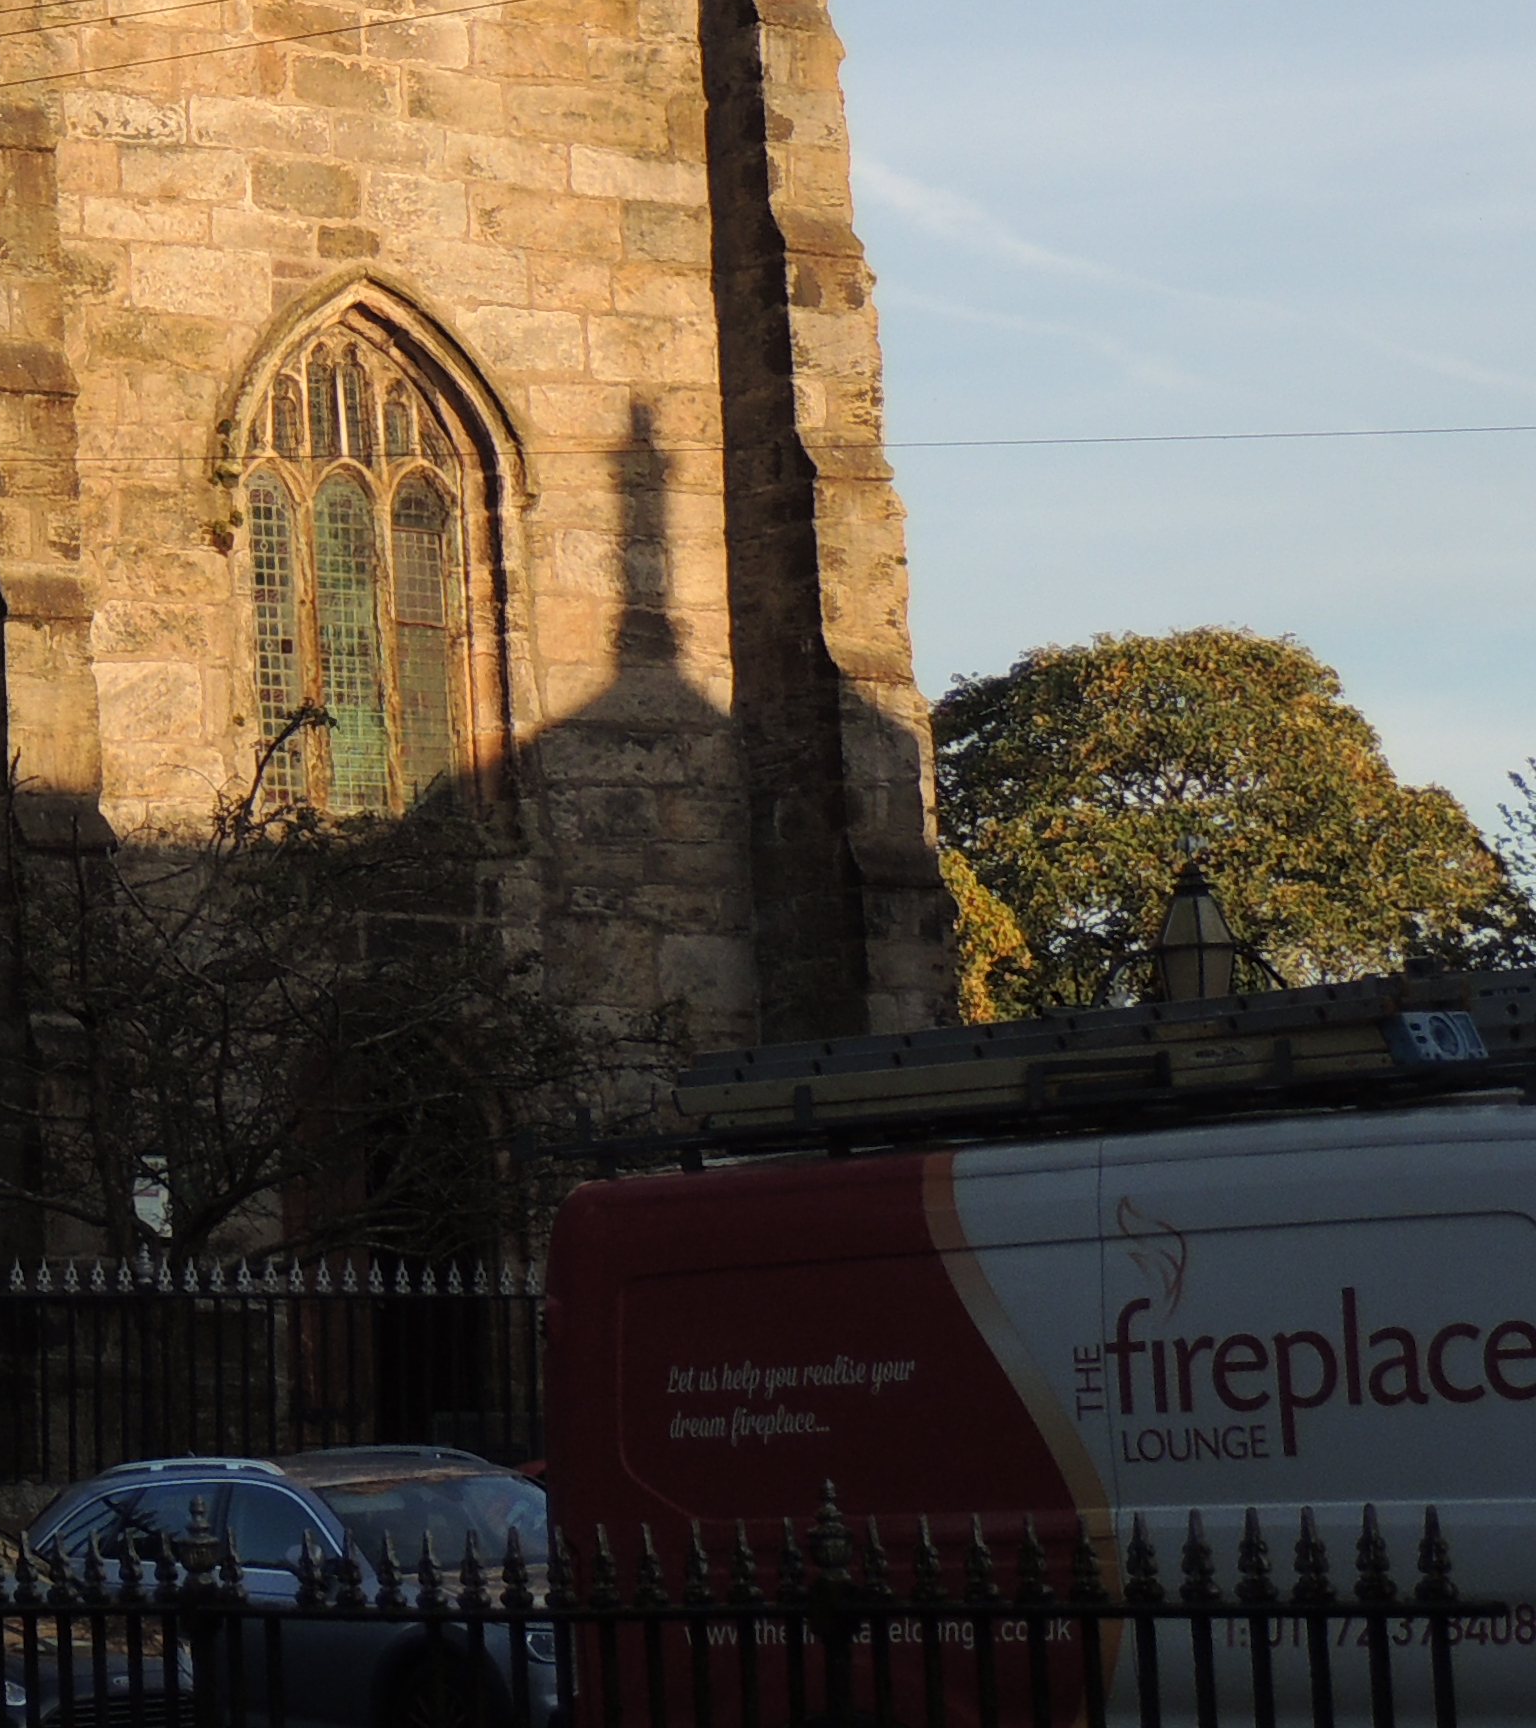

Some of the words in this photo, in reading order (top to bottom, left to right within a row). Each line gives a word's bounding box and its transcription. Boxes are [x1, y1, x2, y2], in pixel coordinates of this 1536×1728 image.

[667, 1365, 694, 1394] Let
[699, 1366, 718, 1391] us
[721, 1360, 760, 1399] help
[764, 1365, 798, 1400] you
[803, 1354, 867, 1386] realise
[870, 1359, 915, 1396] your
[1073, 1343, 1104, 1421] THE
[1104, 1286, 1536, 1457] fireplace
[669, 1411, 726, 1439] dream
[730, 1404, 830, 1448] fireplace...
[1122, 1425, 1269, 1463] LOUNGE
